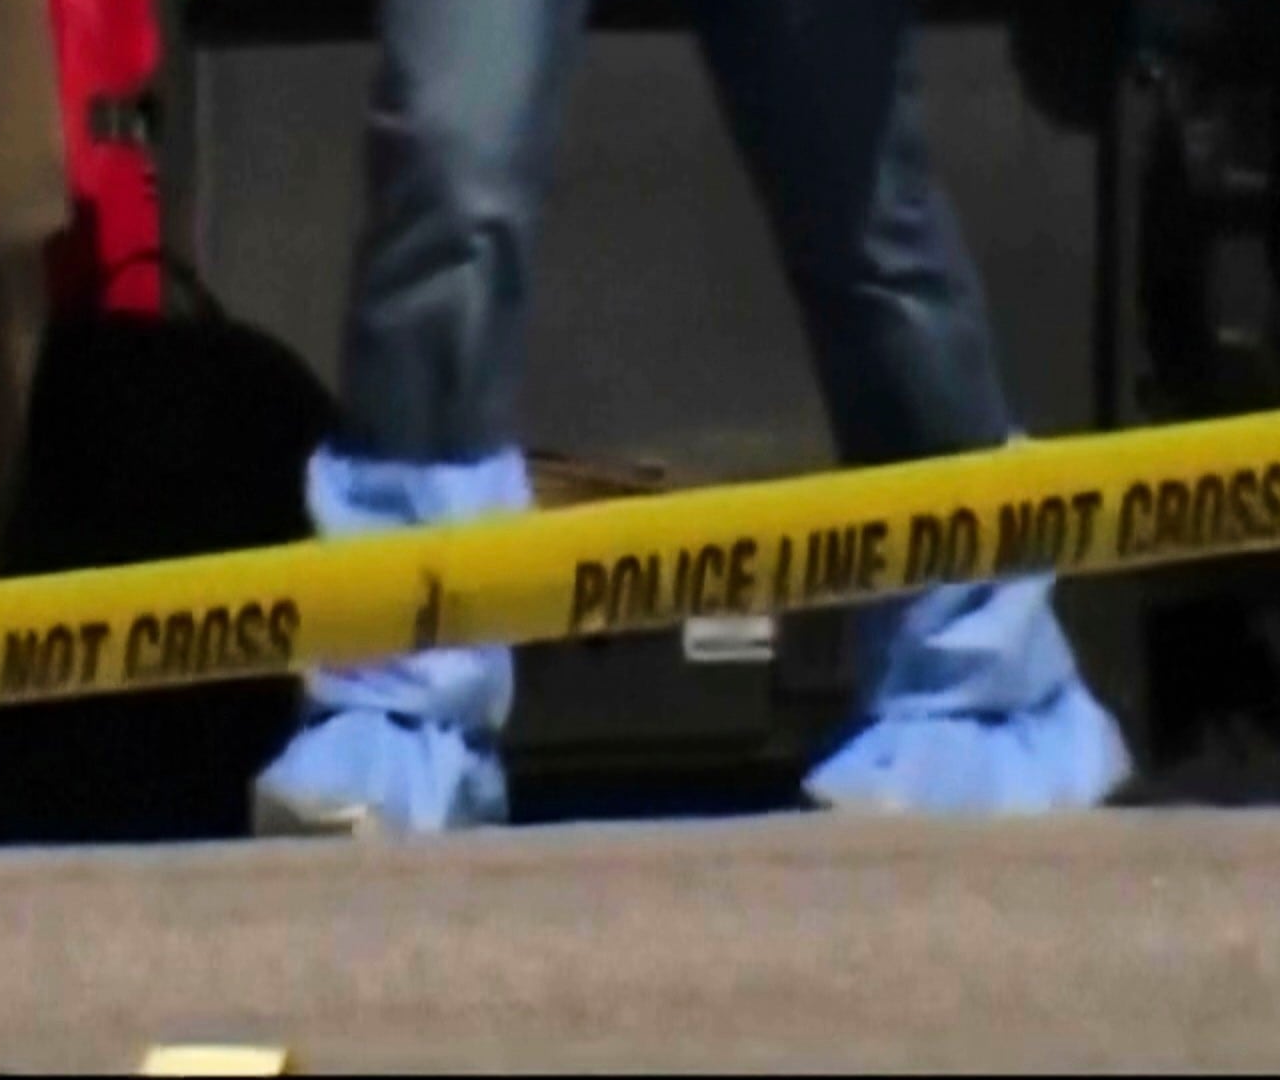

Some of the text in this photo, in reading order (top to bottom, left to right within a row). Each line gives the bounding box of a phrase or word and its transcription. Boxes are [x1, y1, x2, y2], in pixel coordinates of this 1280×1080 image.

[572, 536, 757, 631] POLICE
[774, 522, 888, 608] LINE
[904, 507, 980, 584] DO
[995, 491, 1103, 575] NOT
[123, 598, 302, 680] CROSS
